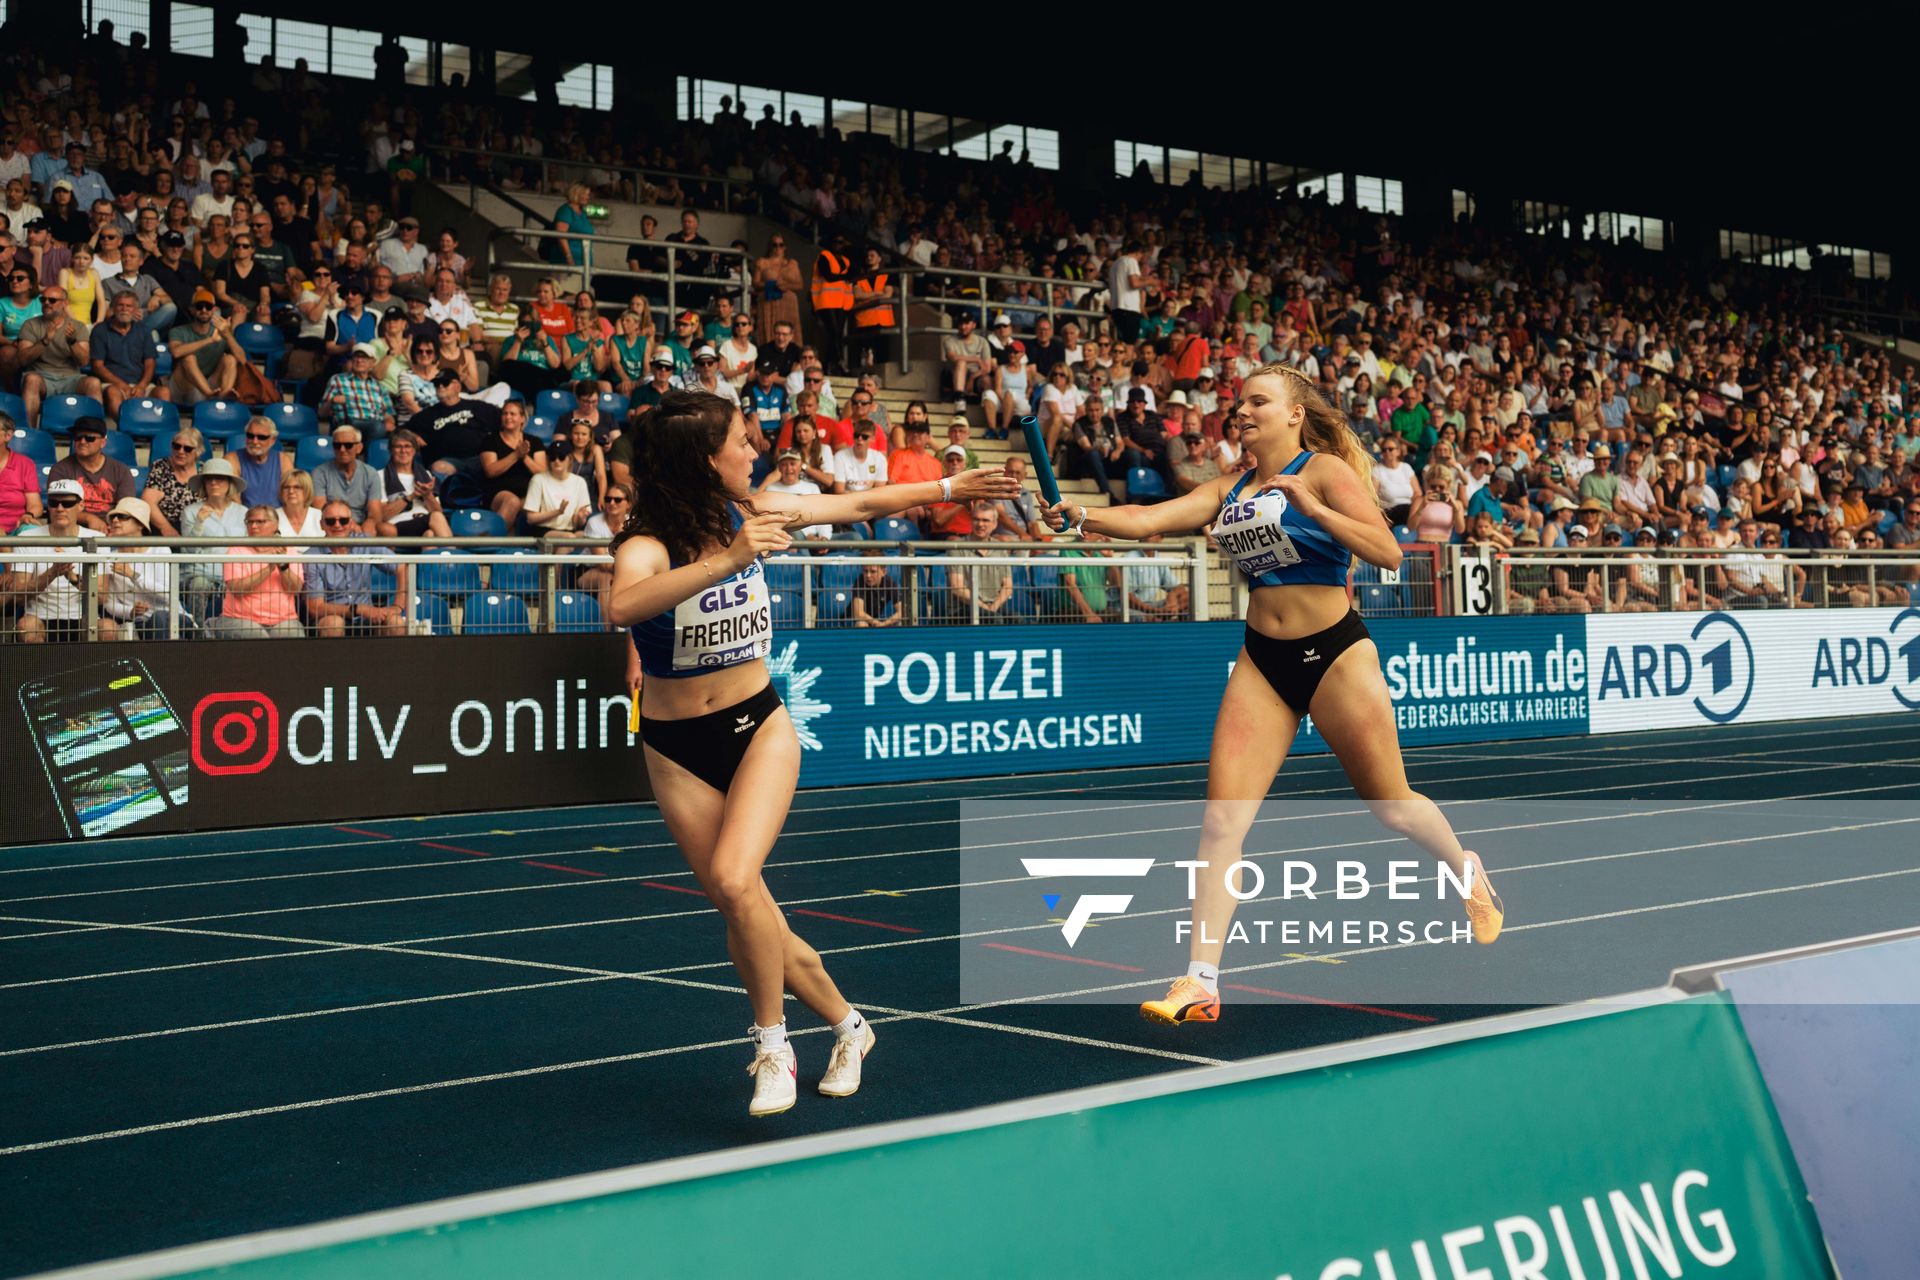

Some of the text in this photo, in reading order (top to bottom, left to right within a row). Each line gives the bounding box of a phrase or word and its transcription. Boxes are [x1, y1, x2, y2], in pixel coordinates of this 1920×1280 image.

[1251, 554, 1277, 568] PLAN
[1461, 565, 1492, 614] 13
[681, 606, 768, 648] FRERICKS
[723, 646, 753, 662] PLAN
[864, 648, 1063, 706] POLIZEI
[1382, 634, 1586, 700] studium.de
[1598, 643, 1692, 700] ARD
[1812, 637, 1890, 688] ARD
[287, 679, 636, 774] dlv_onlin
[864, 713, 1142, 760] NIEDERSACHSEN
[1274, 1169, 1737, 1280] ERUNG
